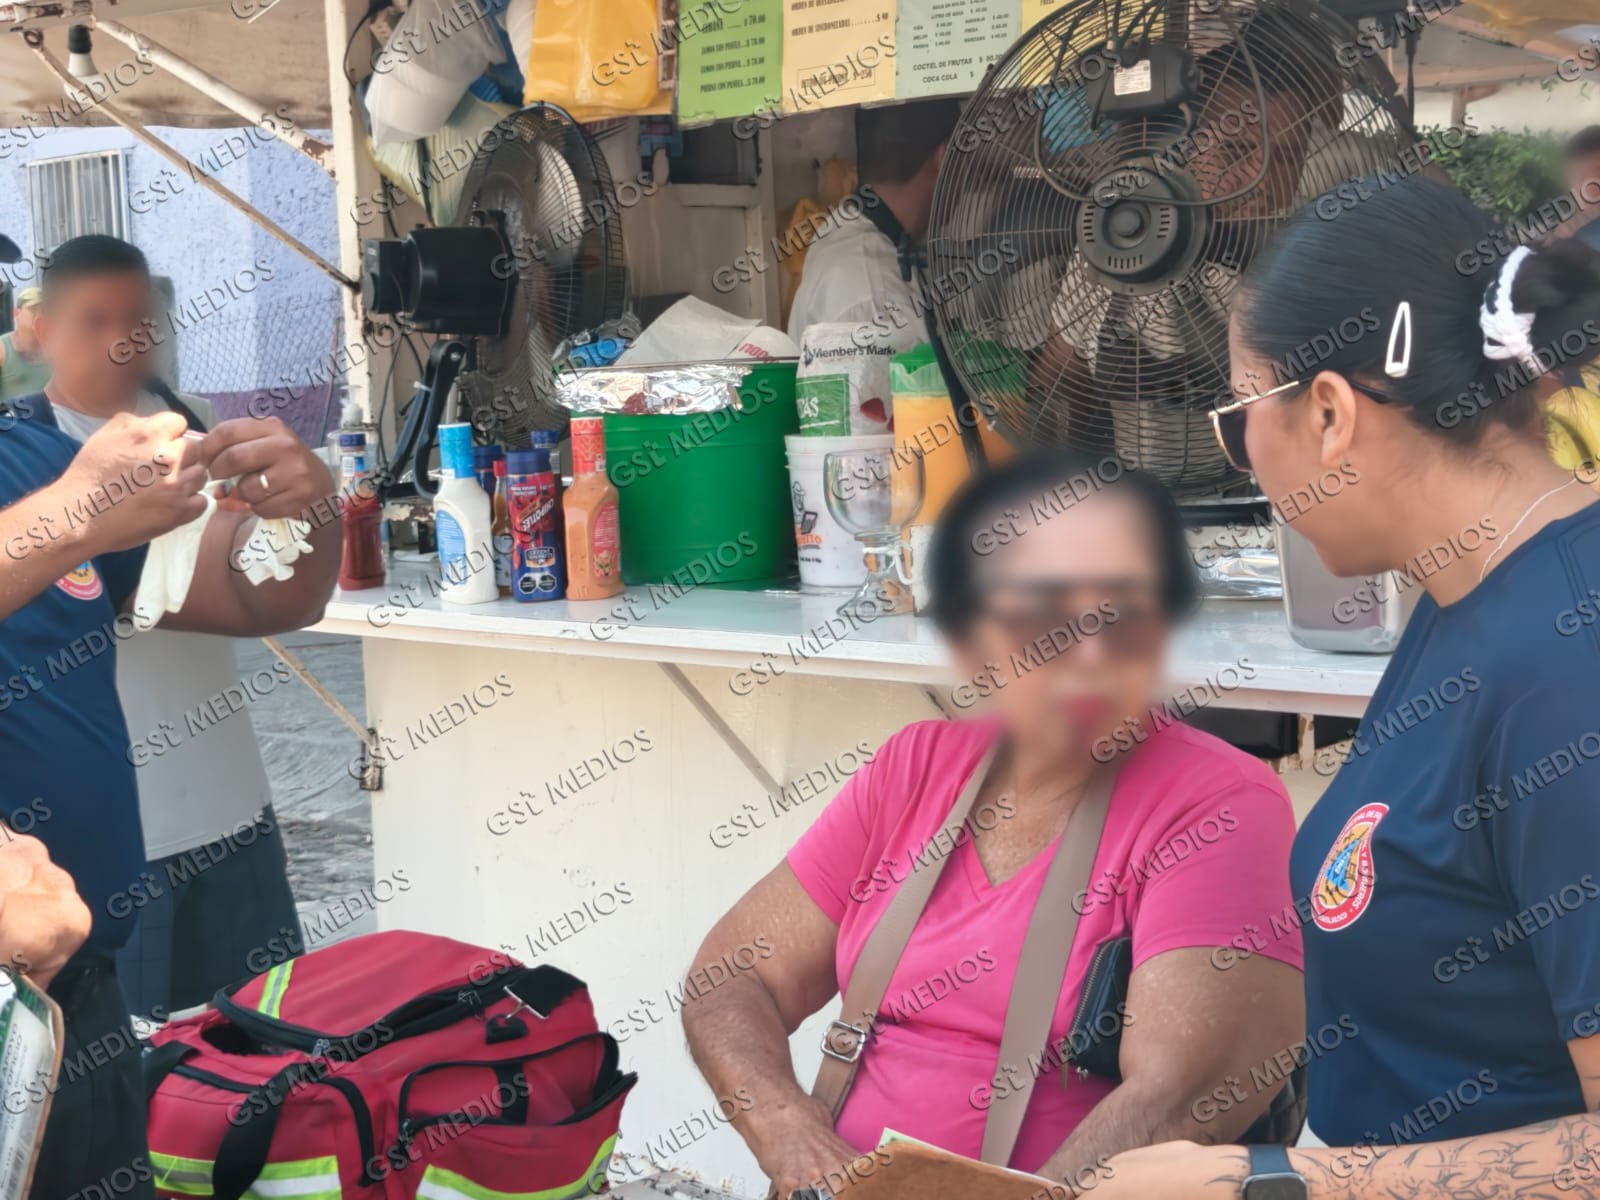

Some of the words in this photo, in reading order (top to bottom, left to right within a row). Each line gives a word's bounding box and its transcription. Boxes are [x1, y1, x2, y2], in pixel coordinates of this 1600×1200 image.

[913, 62, 937, 71] COCTEL
[947, 58, 973, 66] FRUTAS
[941, 73, 958, 81] COLA
